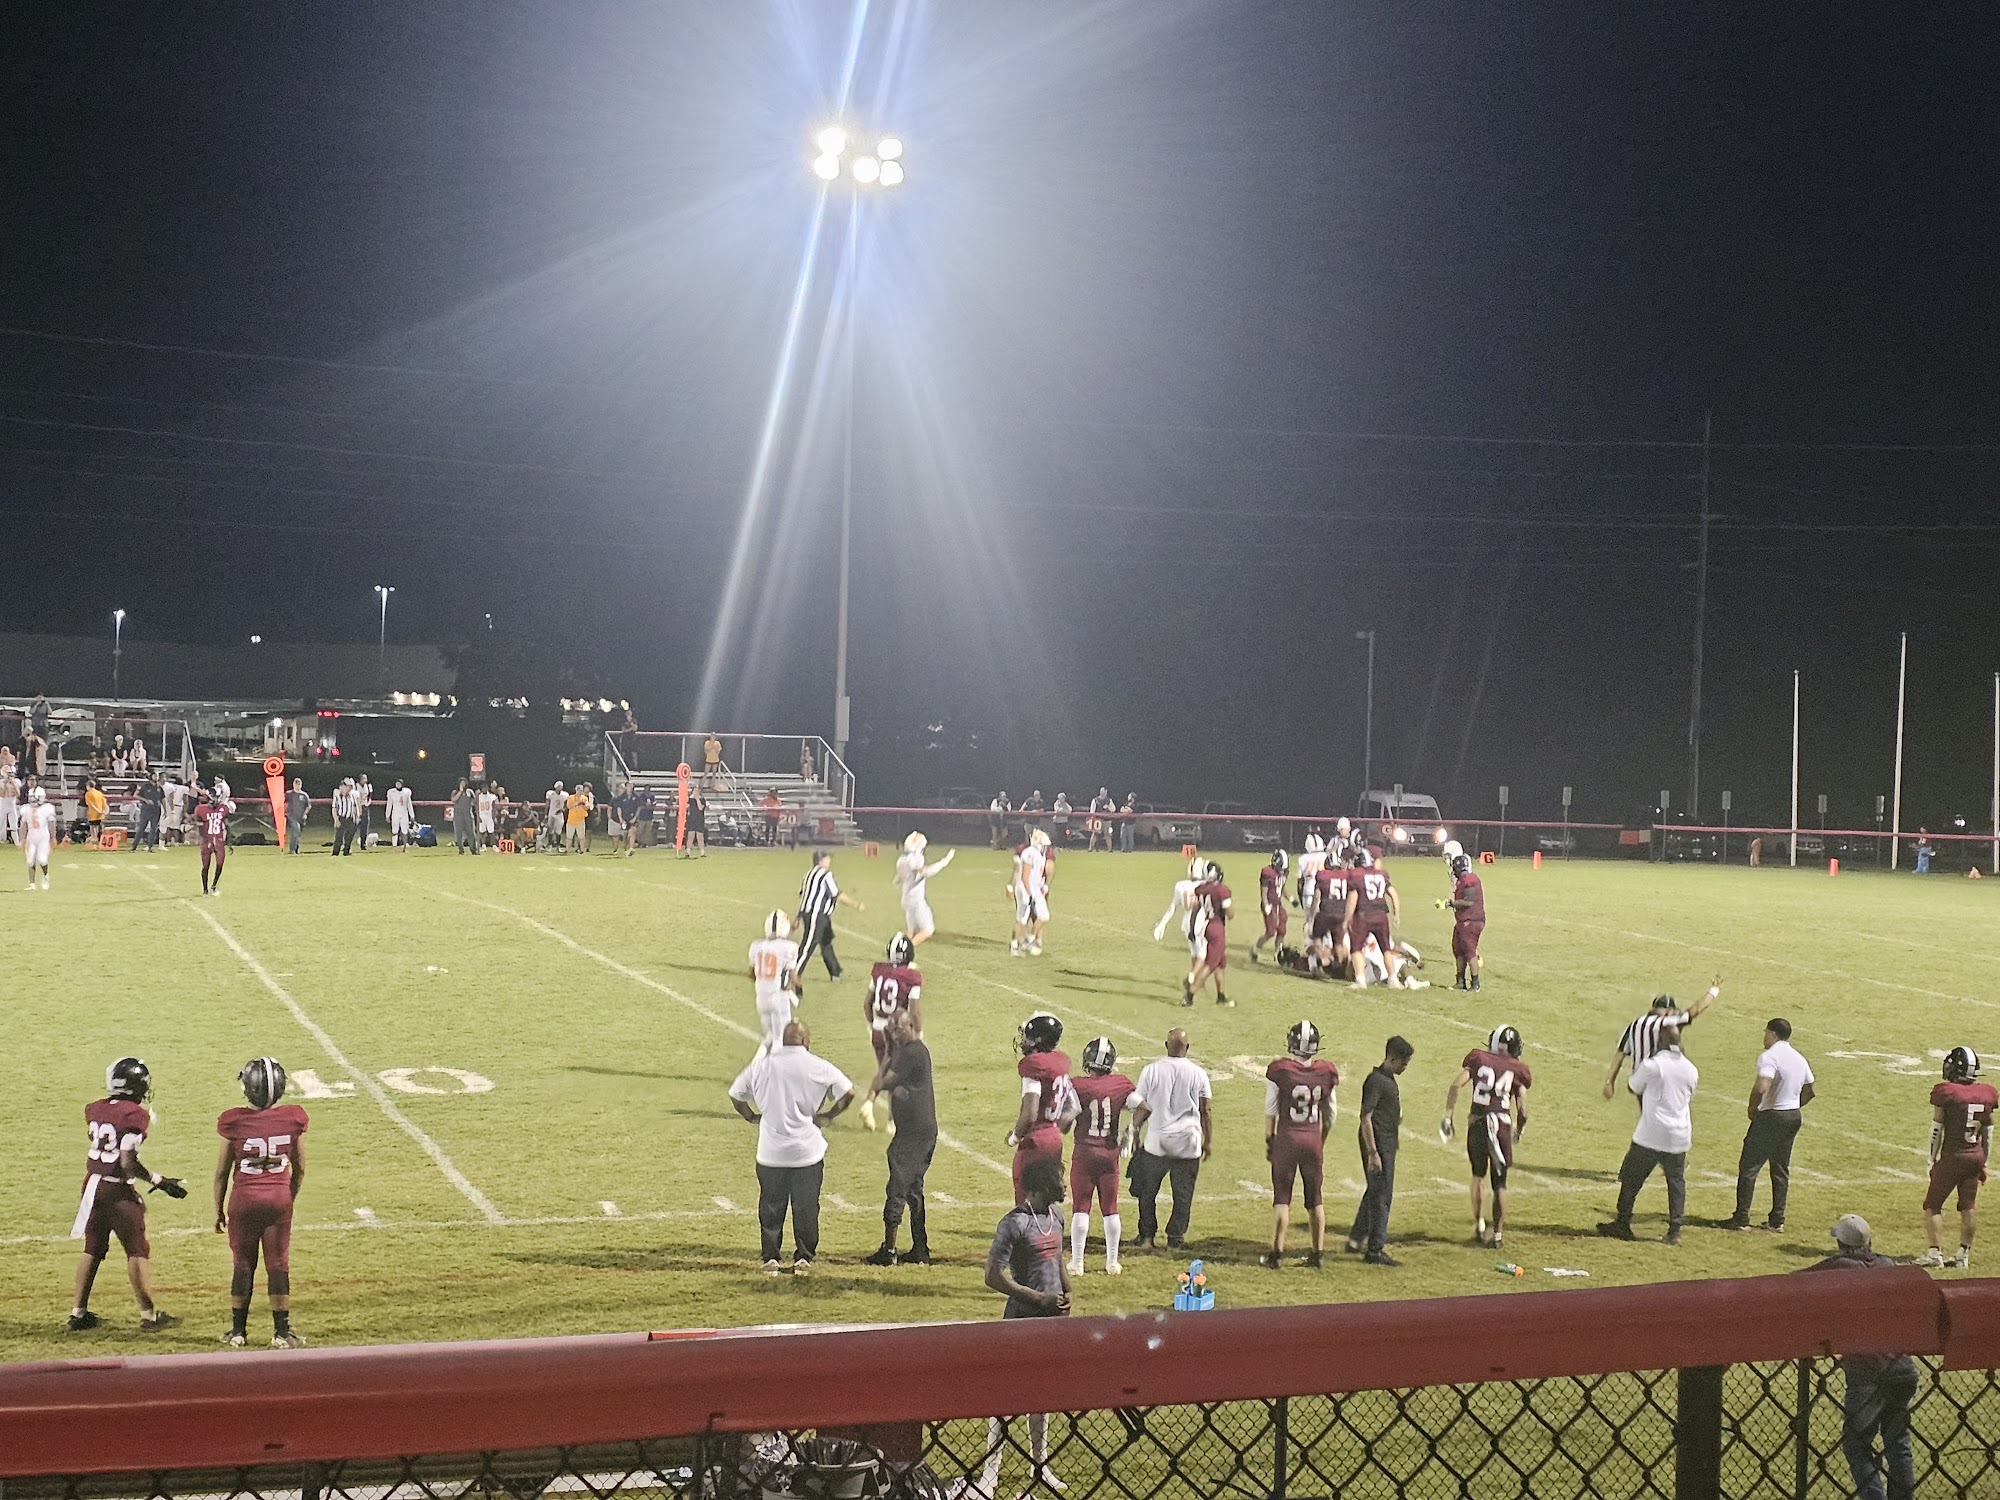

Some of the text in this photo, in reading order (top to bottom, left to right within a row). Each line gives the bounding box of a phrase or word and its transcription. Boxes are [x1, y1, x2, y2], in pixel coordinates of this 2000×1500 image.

[207, 819, 222, 835] 18
[779, 814, 797, 825] 20
[1087, 819, 1102, 830] 10
[1382, 824, 1393, 835] G
[101, 837, 114, 847] 40
[500, 842, 513, 853] 30
[1484, 853, 1494, 864] G
[1364, 874, 1386, 901] 57
[757, 951, 777, 979] 19
[874, 975, 899, 1013] 13
[1473, 1065, 1515, 1109] 24
[1088, 1096, 1112, 1138] 11
[1289, 1085, 1323, 1123] 31
[1965, 1103, 1985, 1143] 5
[240, 1135, 291, 1175] 25
